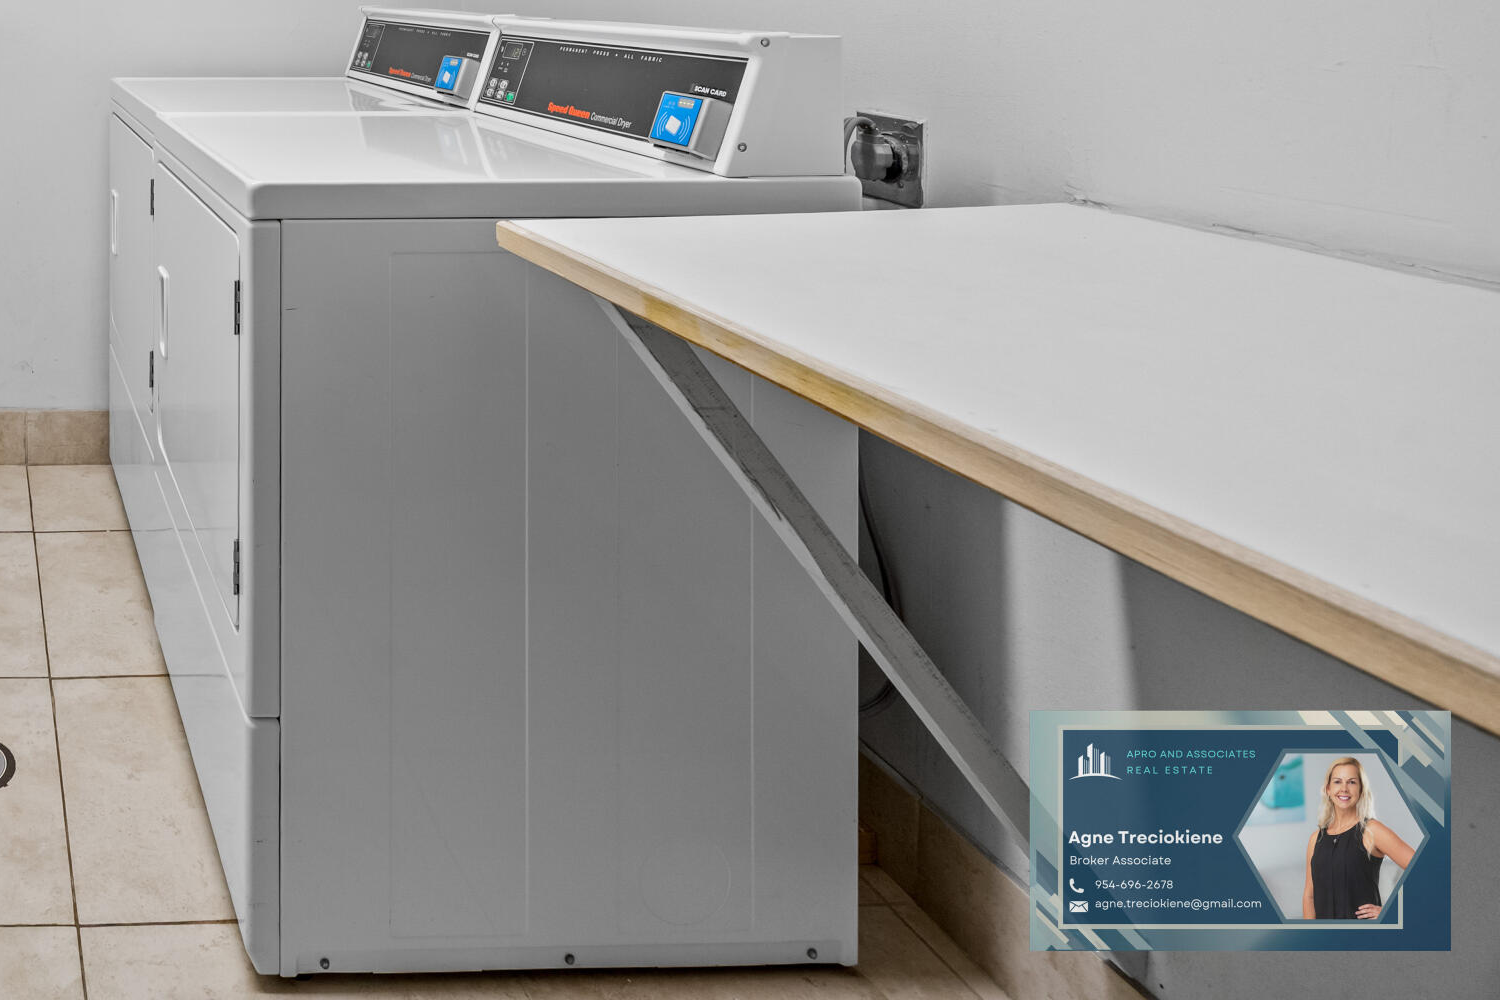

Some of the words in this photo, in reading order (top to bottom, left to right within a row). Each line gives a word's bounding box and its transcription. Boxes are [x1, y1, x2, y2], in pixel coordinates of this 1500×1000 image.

[559, 46, 588, 54] PERMANENT
[592, 49, 610, 57] PRESS
[640, 55, 663, 63] FABRIC
[694, 85, 710, 94] SCAN
[710, 88, 727, 97] CARD
[548, 101, 569, 114] Speed
[568, 105, 591, 119] Queen
[590, 111, 618, 126] Commercial
[617, 117, 633, 130] Dryer
